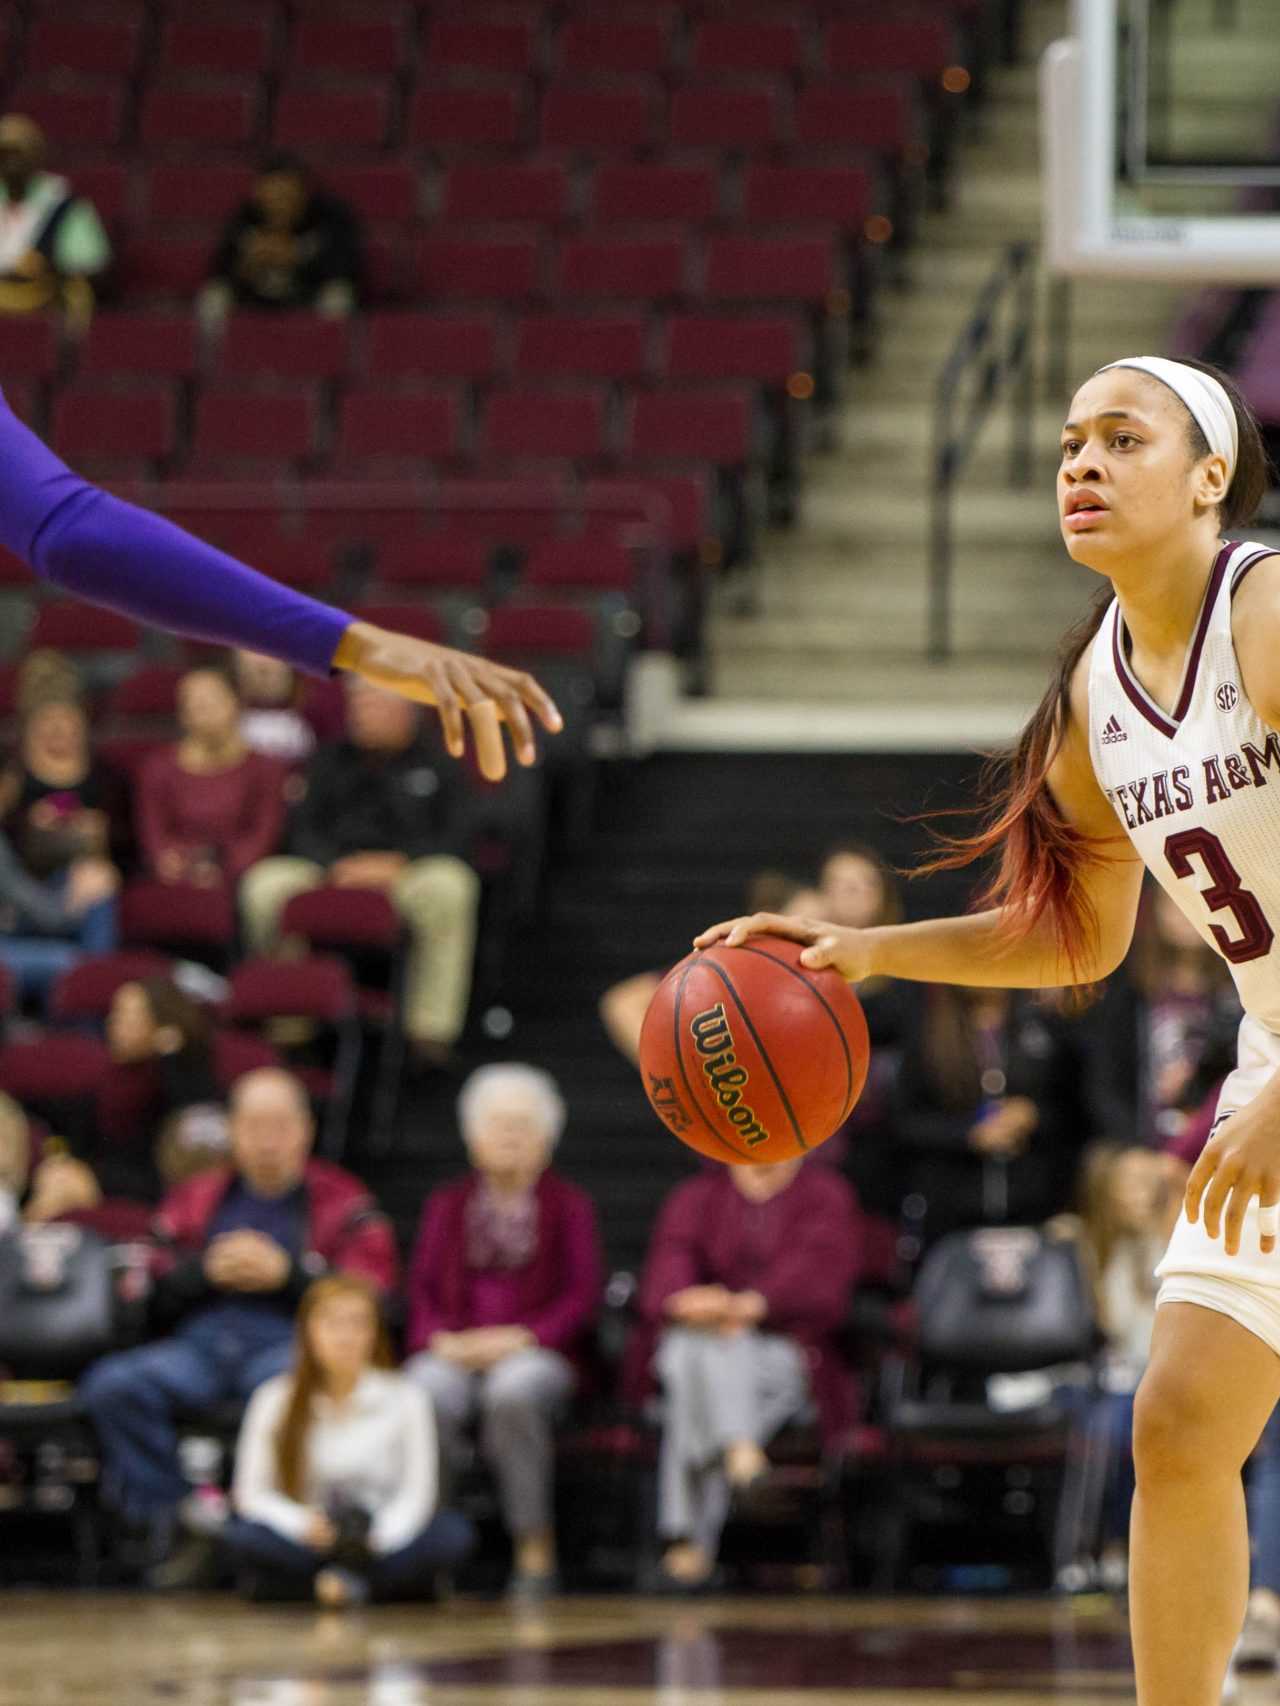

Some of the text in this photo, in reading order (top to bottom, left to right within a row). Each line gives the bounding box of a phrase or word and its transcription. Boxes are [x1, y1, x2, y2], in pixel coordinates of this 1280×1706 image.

[1216, 684, 1237, 710] SEC
[1164, 826, 1275, 964] 3
[690, 1002, 769, 1147] Wilson
